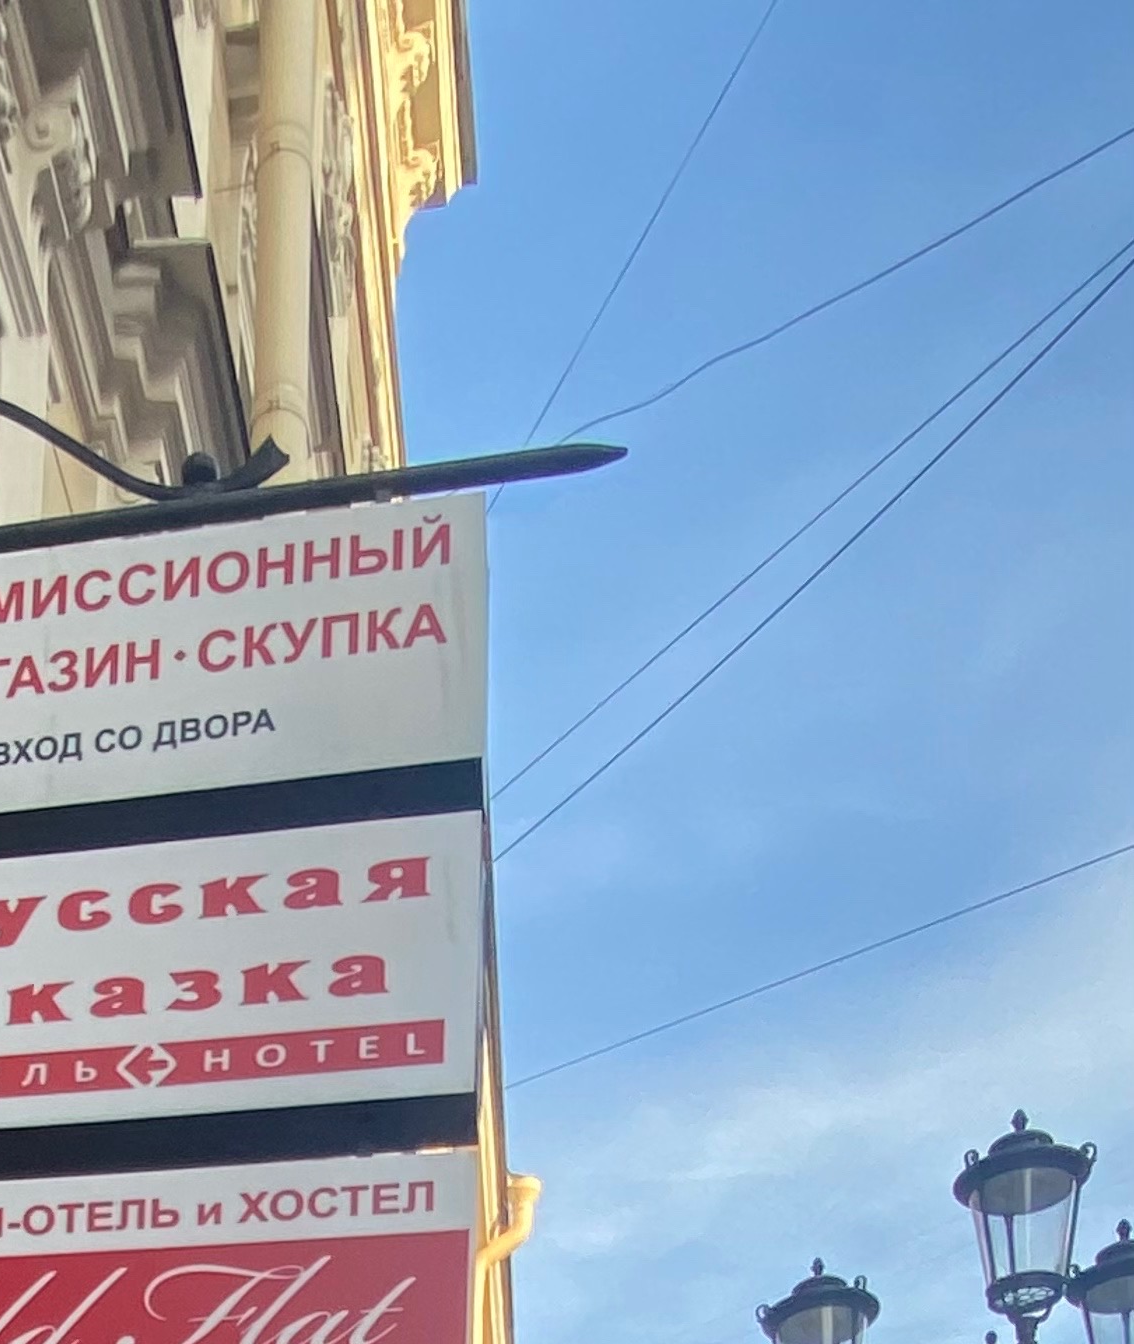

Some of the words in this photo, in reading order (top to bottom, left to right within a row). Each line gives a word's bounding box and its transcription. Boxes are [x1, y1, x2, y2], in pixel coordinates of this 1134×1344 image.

[197, 603, 447, 673] СКУПКА
[96, 726, 142, 754] СО
[153, 709, 275, 750] ДВОРА
[204, 1032, 426, 1072] HOTEL
[198, 1203, 222, 1226] и
[238, 1181, 435, 1223] ХОСТЕЛ
